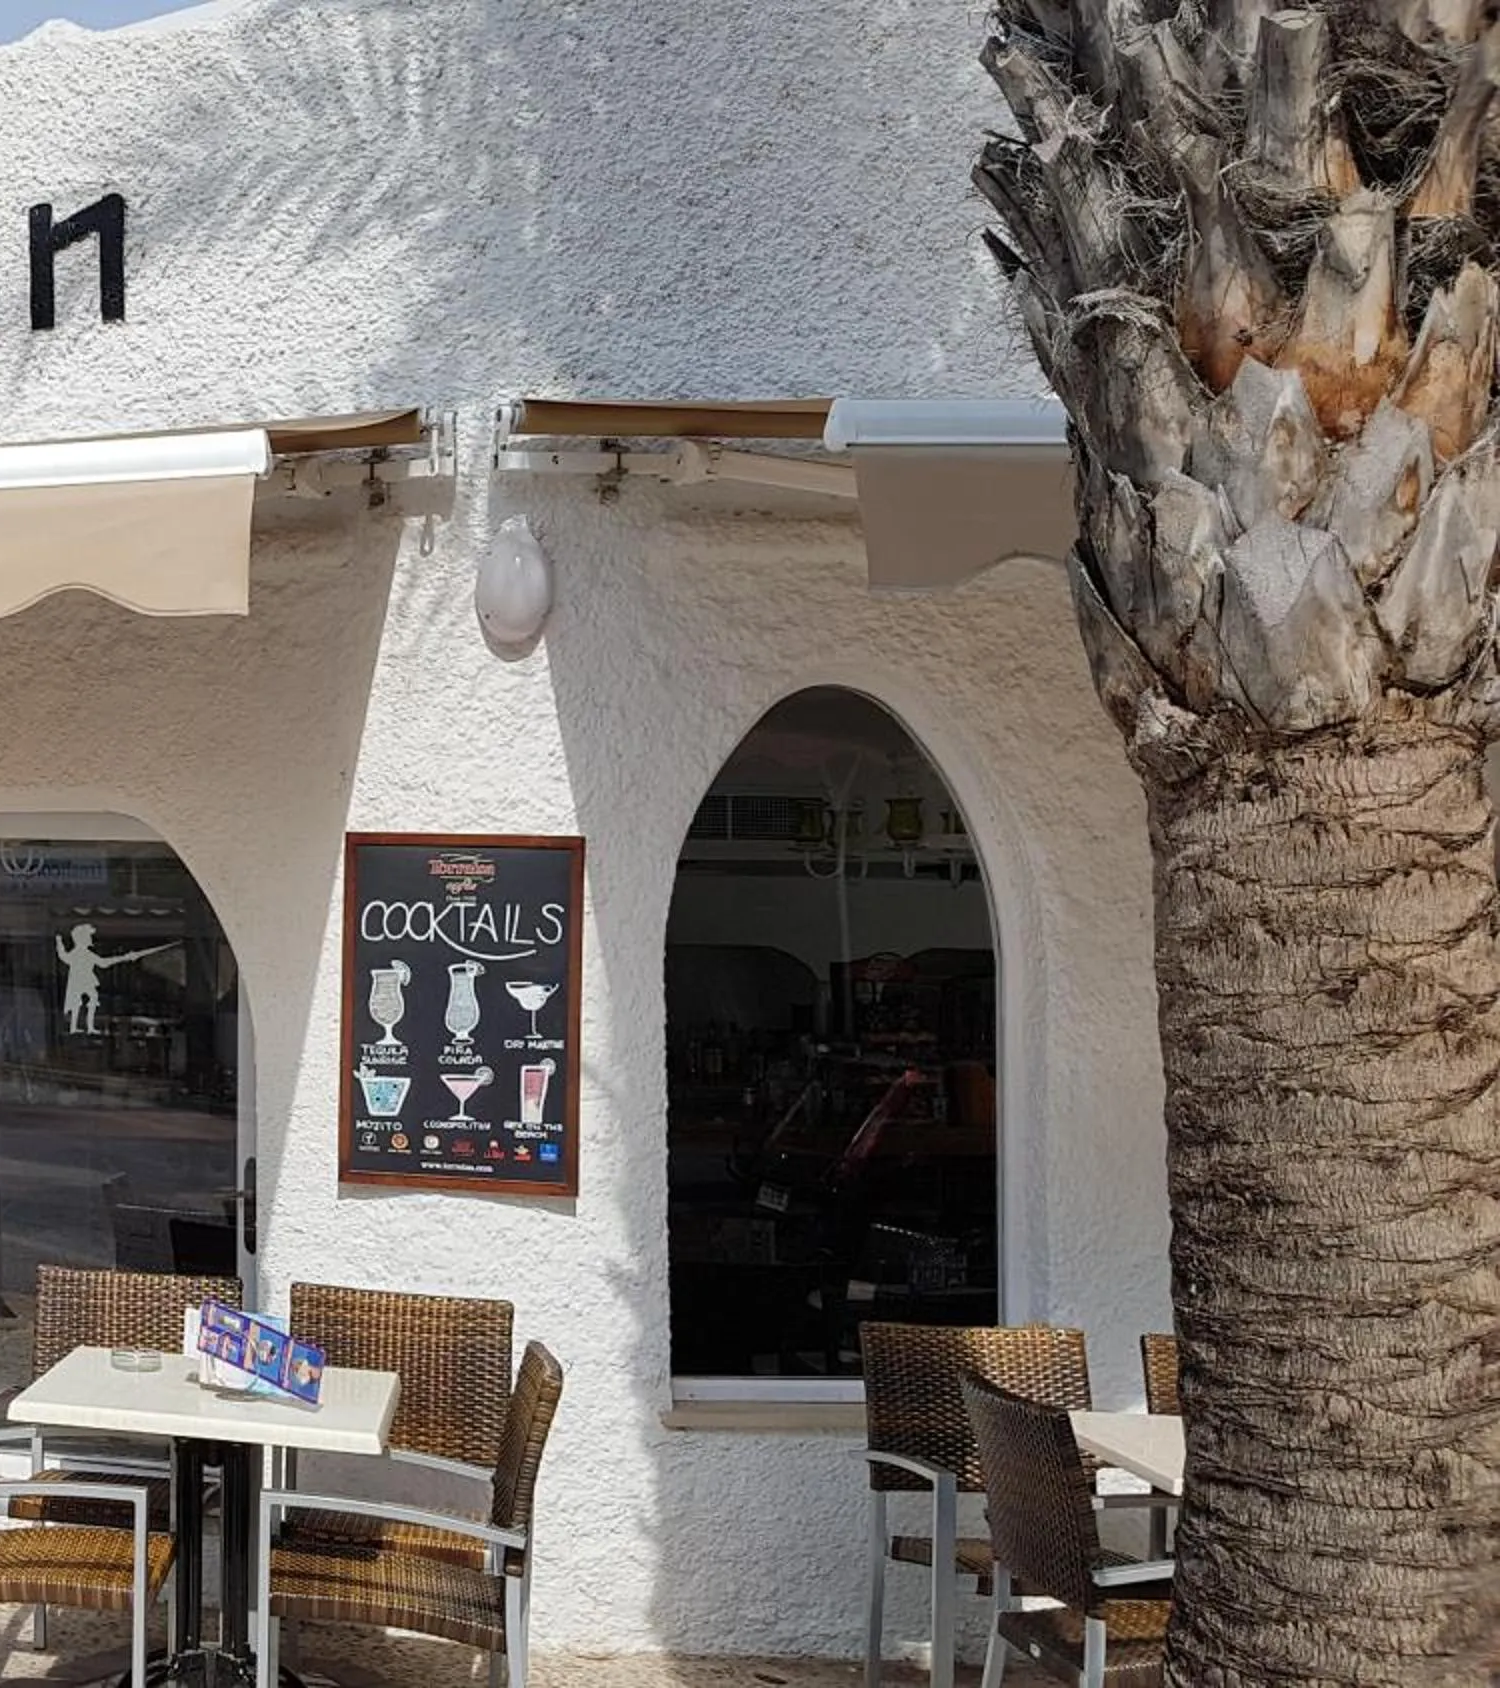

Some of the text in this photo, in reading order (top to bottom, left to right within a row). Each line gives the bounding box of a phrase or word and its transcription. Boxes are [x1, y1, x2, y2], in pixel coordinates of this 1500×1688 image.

[361, 900, 565, 959] COCKTAILS
[360, 1043, 409, 1056] TEQUILA
[438, 1055, 483, 1065] COLADA
[355, 1120, 403, 1131] MOJITO
